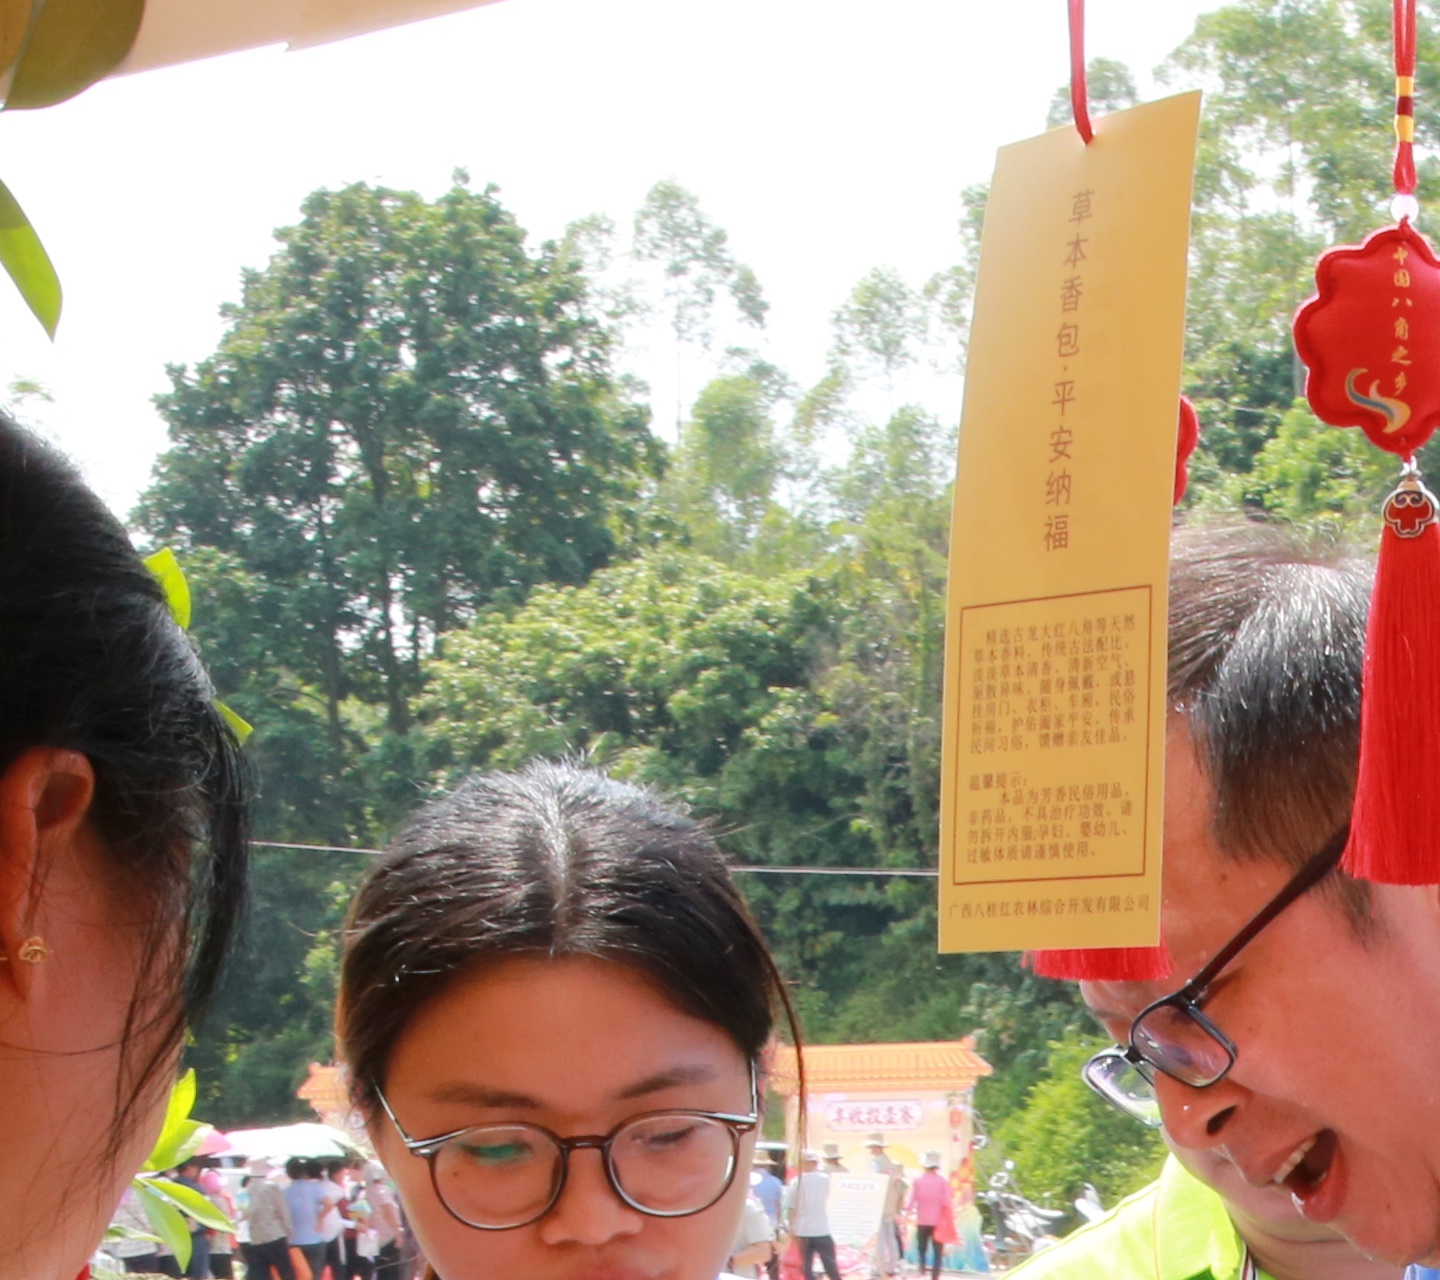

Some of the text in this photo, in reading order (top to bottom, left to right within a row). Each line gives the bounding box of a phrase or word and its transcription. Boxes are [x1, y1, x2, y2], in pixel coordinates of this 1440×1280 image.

[1390, 246, 1412, 396] 中国八角之乡
[949, 895, 1150, 919] 广西八桂红农林综合开发有限公司
